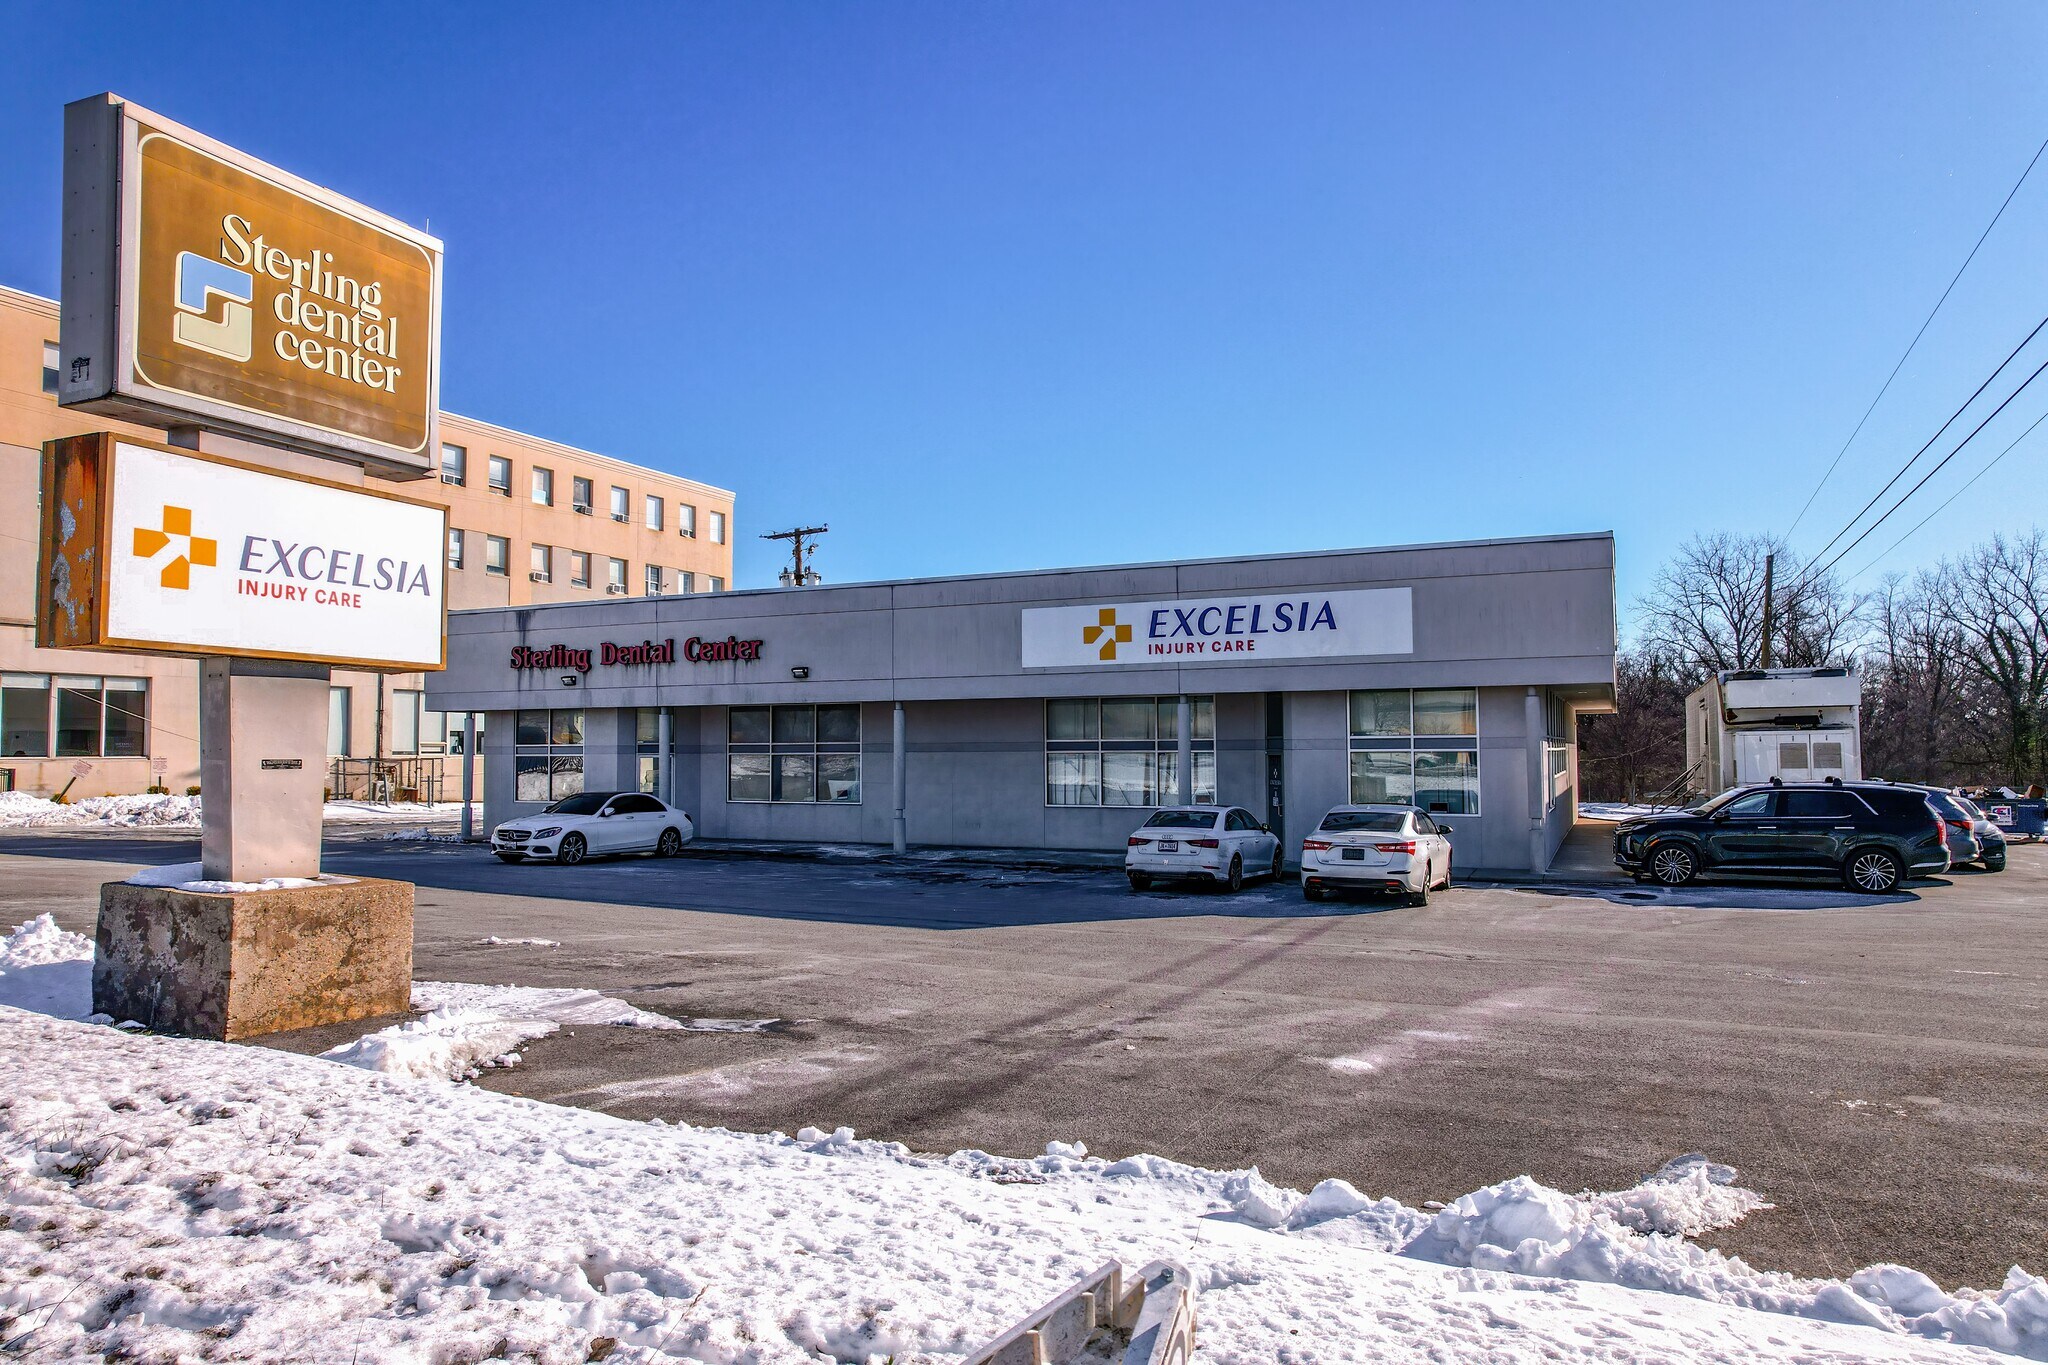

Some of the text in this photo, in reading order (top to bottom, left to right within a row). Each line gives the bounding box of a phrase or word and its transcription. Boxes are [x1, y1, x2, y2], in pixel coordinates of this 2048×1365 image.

[220, 214, 382, 321] Sterling
[273, 287, 397, 360] dental
[274, 330, 401, 393] center
[239, 535, 431, 597] EXCELSIA
[238, 579, 361, 609] INJURY CARE
[1148, 600, 1337, 638] EXCELSIA
[510, 636, 763, 673] Sterling Dental Center
[1148, 640, 1255, 655] INJURY CARE
